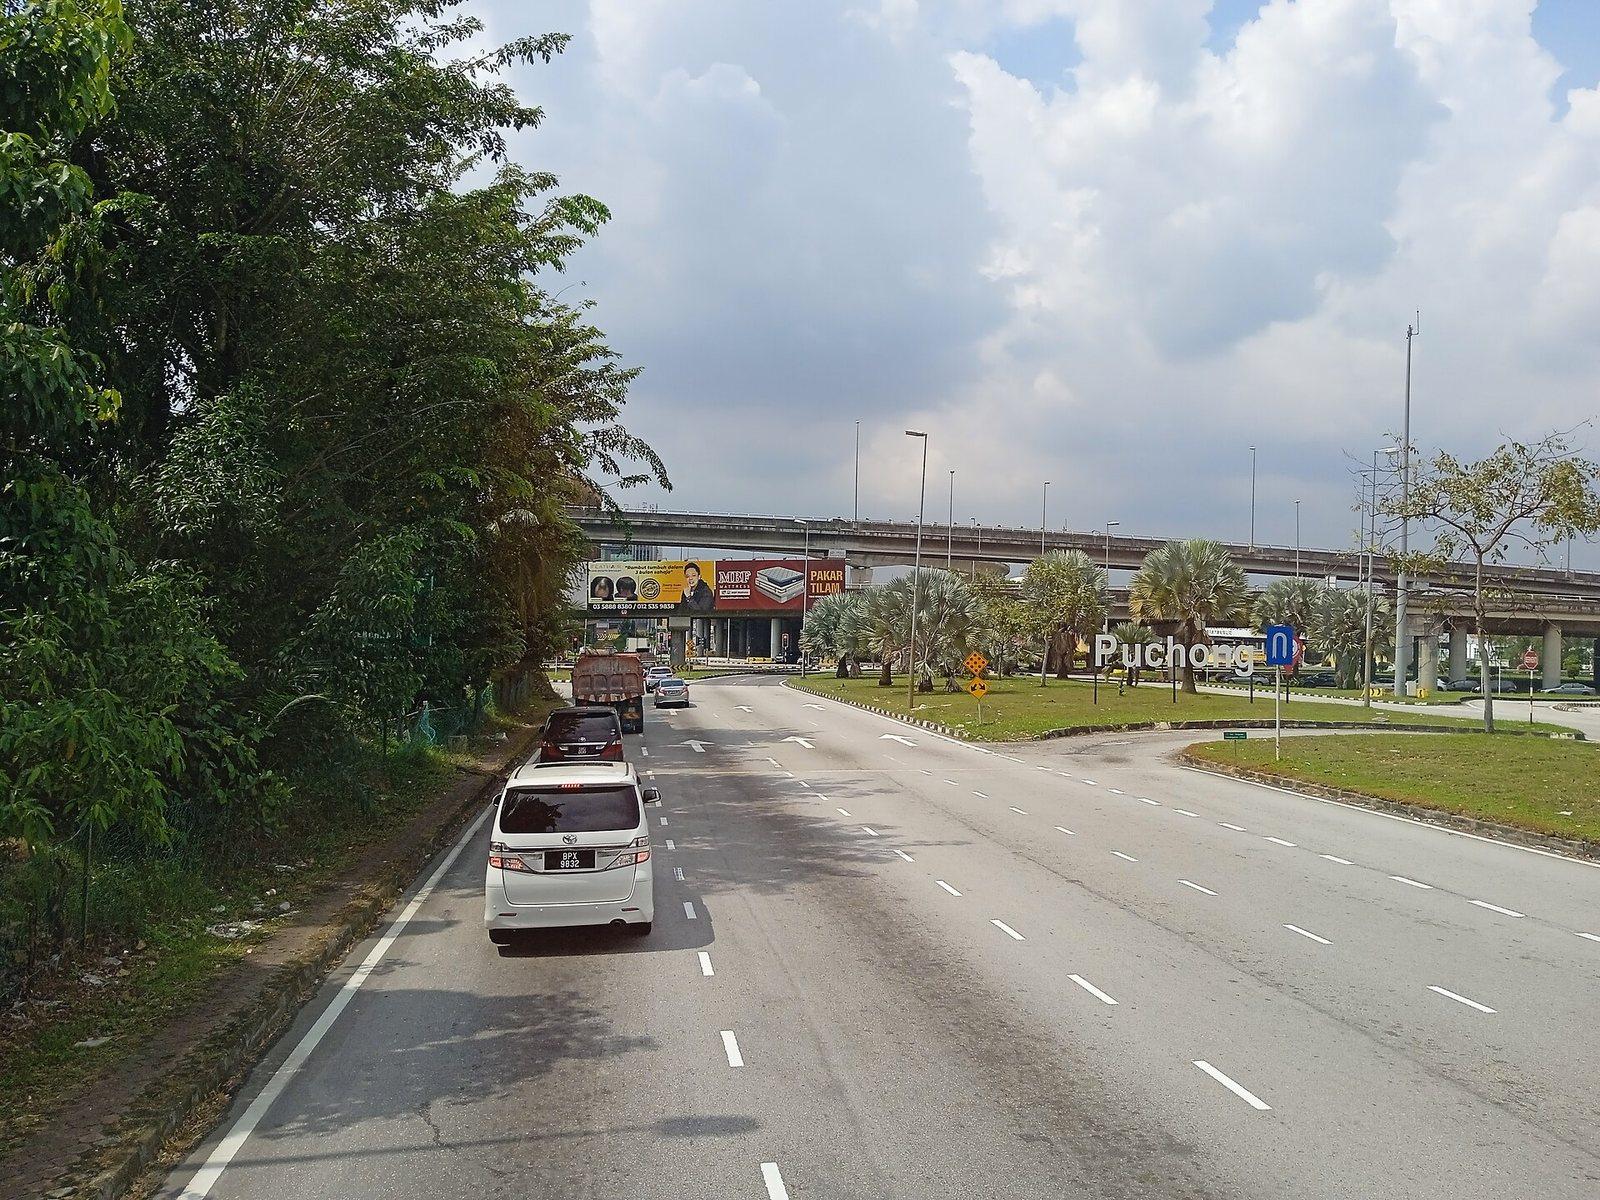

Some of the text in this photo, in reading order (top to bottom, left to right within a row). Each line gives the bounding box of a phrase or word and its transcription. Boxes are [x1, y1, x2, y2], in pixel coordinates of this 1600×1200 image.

[718, 571, 751, 584] MBF
[810, 570, 843, 581] PAKAR
[810, 583, 840, 593] TILAM
[1094, 634, 1254, 677] Puchong
[562, 852, 578, 860] BPX
[560, 860, 580, 868] 9832
